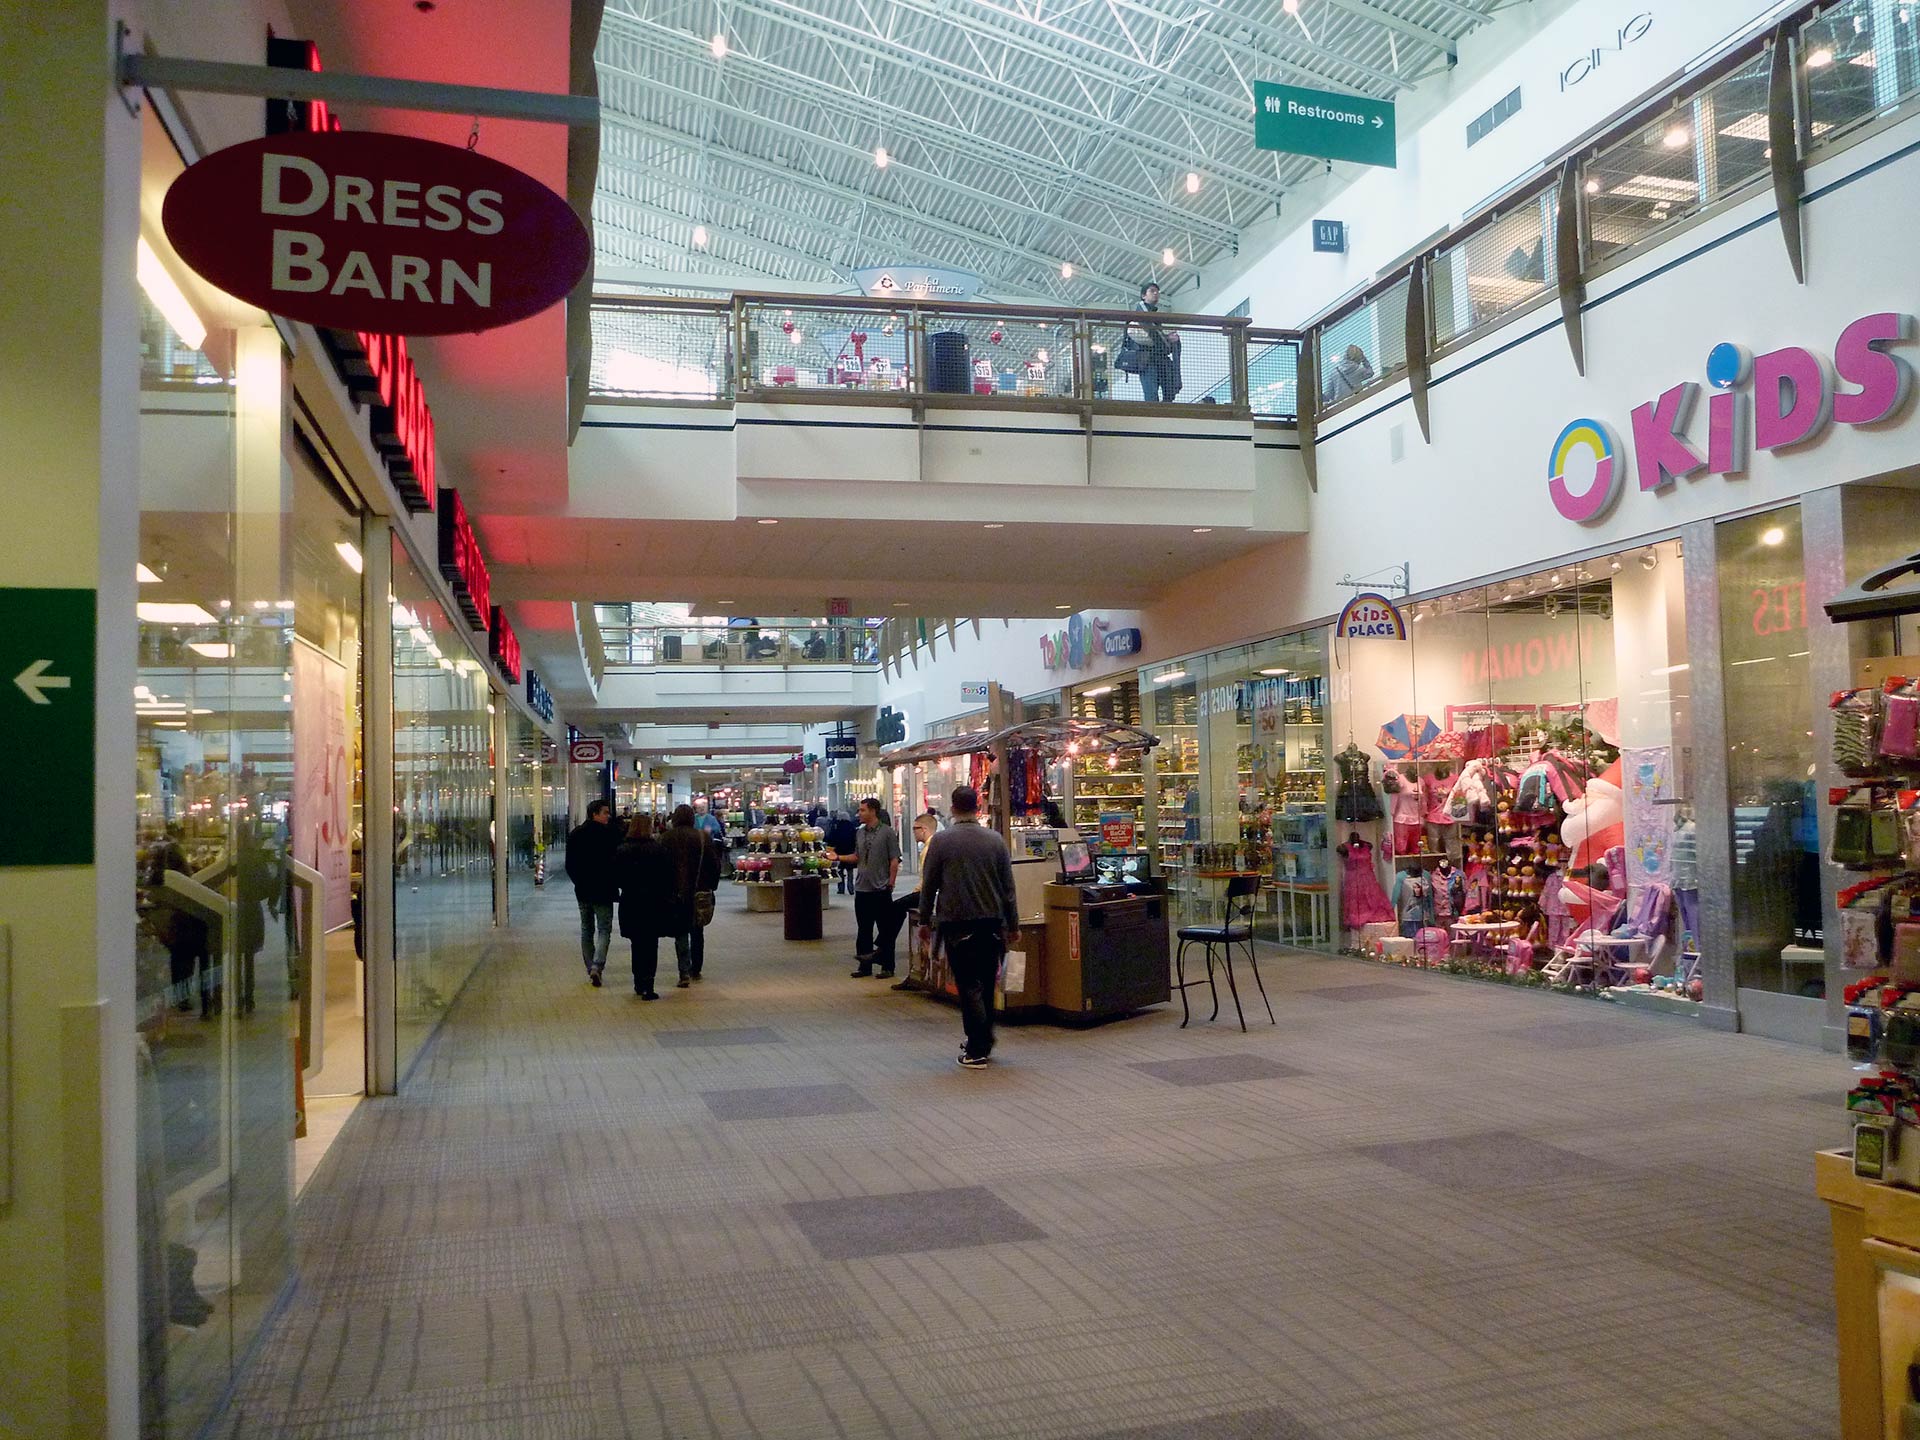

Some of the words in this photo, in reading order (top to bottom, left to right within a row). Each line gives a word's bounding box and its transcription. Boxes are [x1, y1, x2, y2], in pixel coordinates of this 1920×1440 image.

[1560, 12, 1653, 92] ICING
[1288, 101, 1365, 125] Restrooms
[260, 153, 504, 235] DRESS
[1320, 225, 1338, 240] GAP
[271, 229, 492, 307] BARN
[904, 281, 964, 296] Parfumerie
[1348, 623, 1395, 638] PLACE
